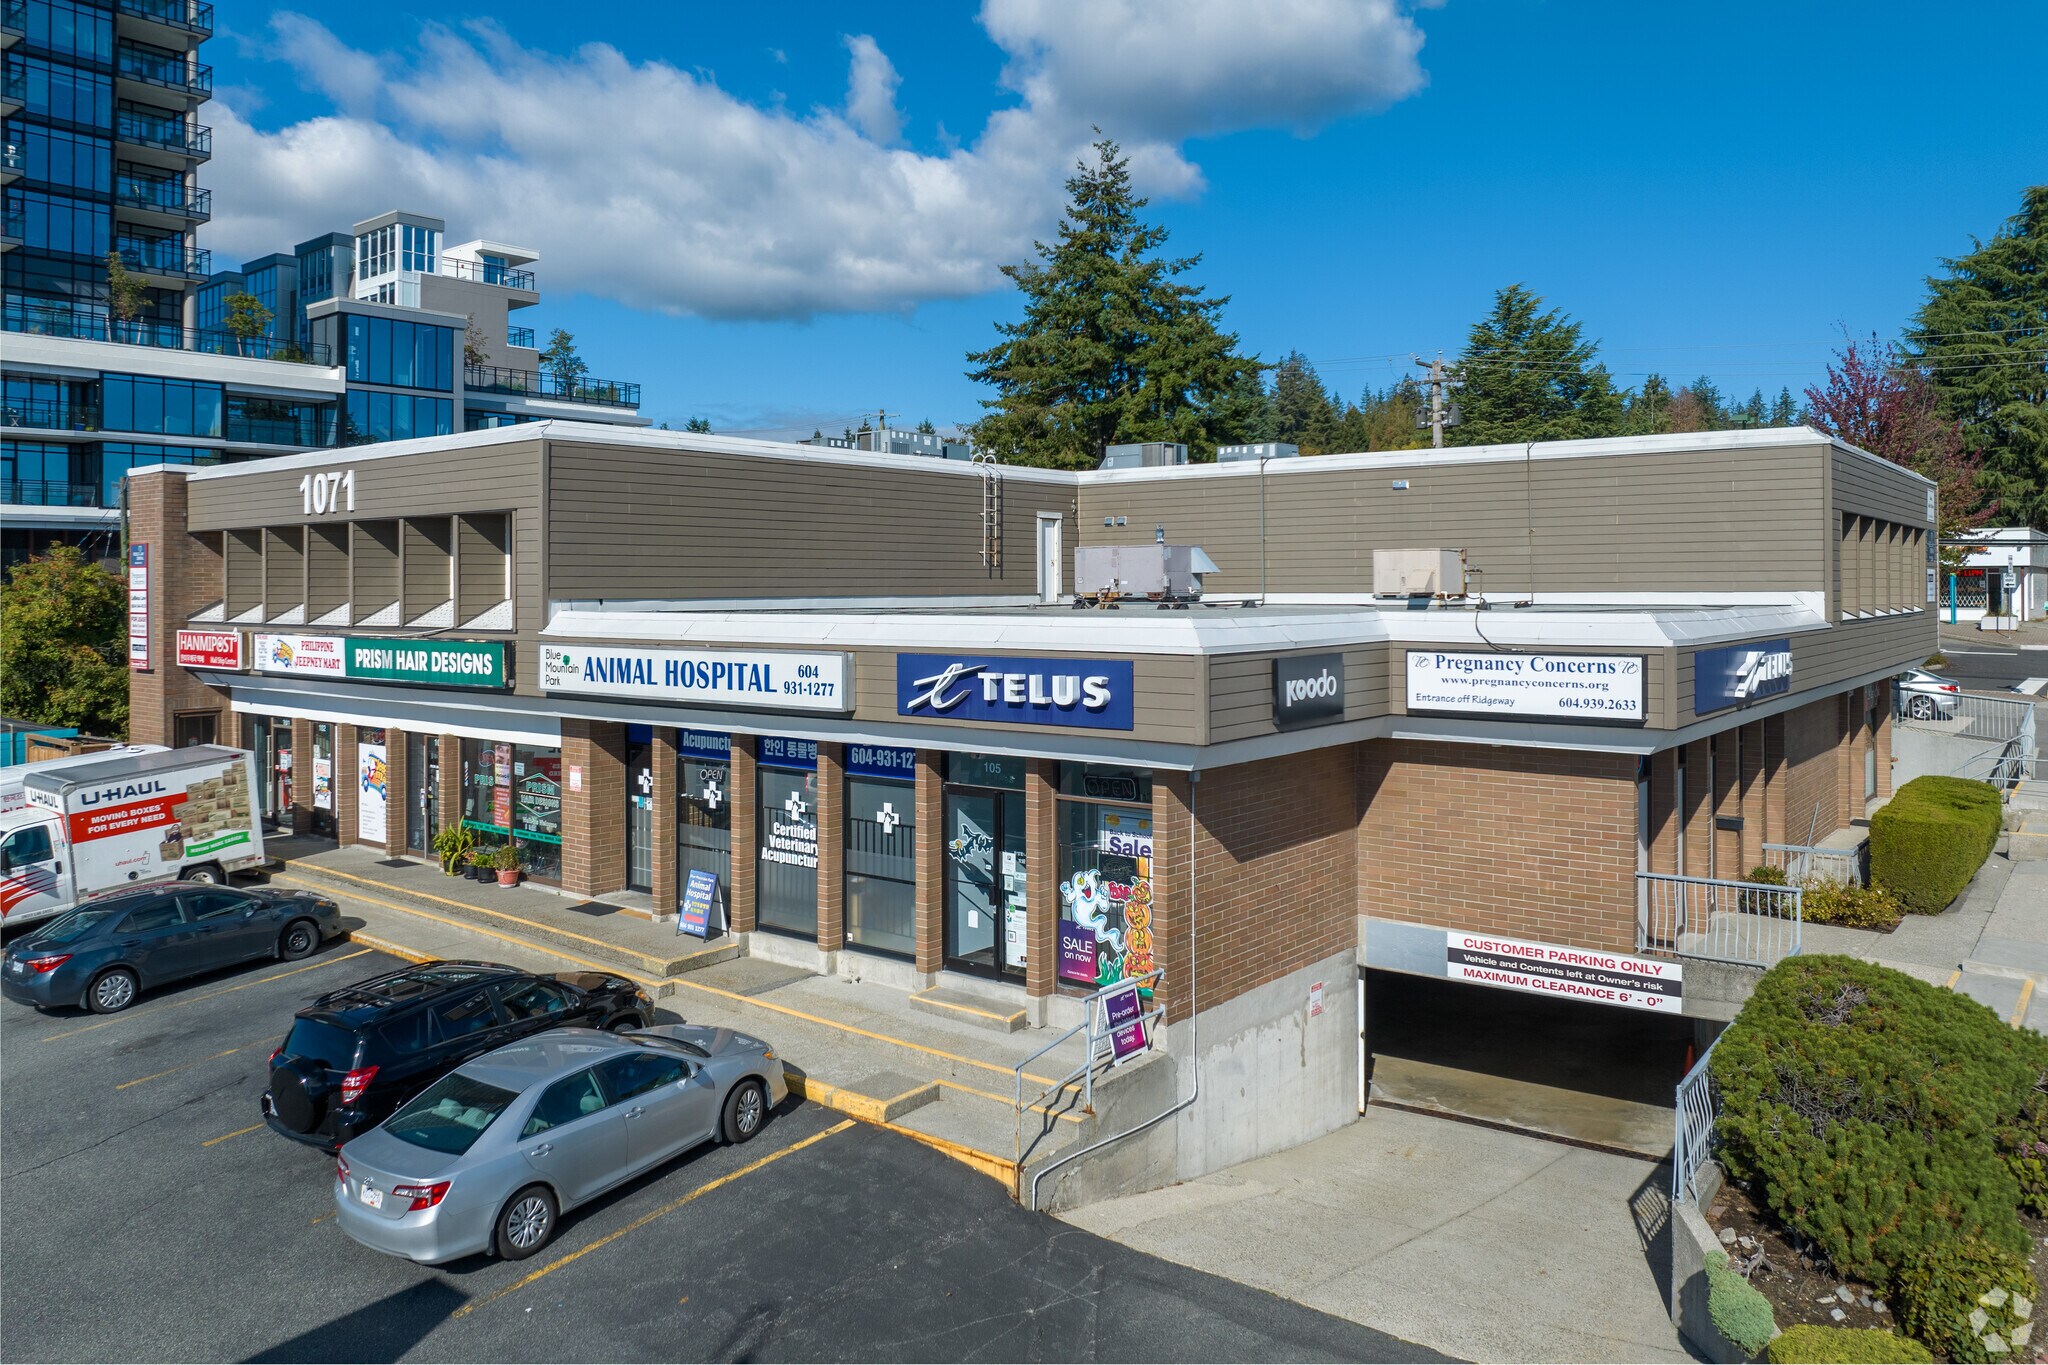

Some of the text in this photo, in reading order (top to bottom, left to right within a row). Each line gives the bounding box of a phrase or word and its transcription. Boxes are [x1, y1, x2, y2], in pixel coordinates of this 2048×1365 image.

[300, 469, 356, 515] 1071
[180, 634, 236, 653] HANMIPOST
[301, 640, 334, 652] PHILIPPINE
[355, 648, 493, 675] PRISM HAIR DESIGNS
[545, 648, 561, 660] Blue
[295, 656, 340, 670] JEEPNEY MART
[545, 661, 579, 675] Mountain
[1435, 654, 1616, 676] Pregnancy Concerns
[583, 656, 778, 693] ANIMAL HOSPITAL
[798, 664, 818, 679] 604
[545, 675, 561, 686] Park
[1286, 667, 1338, 708] koodo
[1441, 677, 1610, 692] www.pregnancyconcerns.org
[784, 682, 834, 697] 931-1277
[977, 671, 1112, 709] TELUS
[1416, 693, 1515, 707] Entrance off Ridgeway
[1558, 697, 1637, 710] 604.939.2633
[764, 738, 818, 760] 한인 동물병
[852, 747, 916, 769] 604-931-12
[700, 768, 722, 780] OPEN
[984, 762, 1001, 774] 105
[474, 774, 494, 786] PRIS
[82, 780, 166, 806] U-HAUL
[525, 781, 555, 796] PRISM
[1087, 780, 1132, 797] OPEN
[30, 790, 58, 808] U-HAUL
[520, 794, 560, 808] HAIR DESIGNS
[91, 804, 161, 824] MOVING BOXES
[88, 813, 166, 834] FOR EVERY NEED
[773, 822, 816, 840] Certified
[1132, 831, 1152, 839] School
[1110, 836, 1152, 858] Sale
[116, 856, 147, 867] uhaul.com
[690, 880, 710, 892] Animal
[686, 888, 712, 900] Hospital
[1063, 936, 1092, 954] SALE
[1064, 952, 1092, 962] on now
[1464, 938, 1662, 976] CUSTOMER PARKING ONLY
[1464, 954, 1498, 966] Vehicle
[1499, 960, 1518, 969] and
[1519, 962, 1564, 976] Contents
[1566, 970, 1583, 979] left
[1598, 975, 1641, 988] Owner's
[1643, 982, 1664, 992] risk
[1464, 968, 1528, 986] MAXIMUM
[1532, 979, 1615, 1000] CLEARANCE
[1620, 992, 1632, 1002] 6'
[1112, 1006, 1134, 1020] Pre-order
[1116, 1025, 1135, 1038] devices
